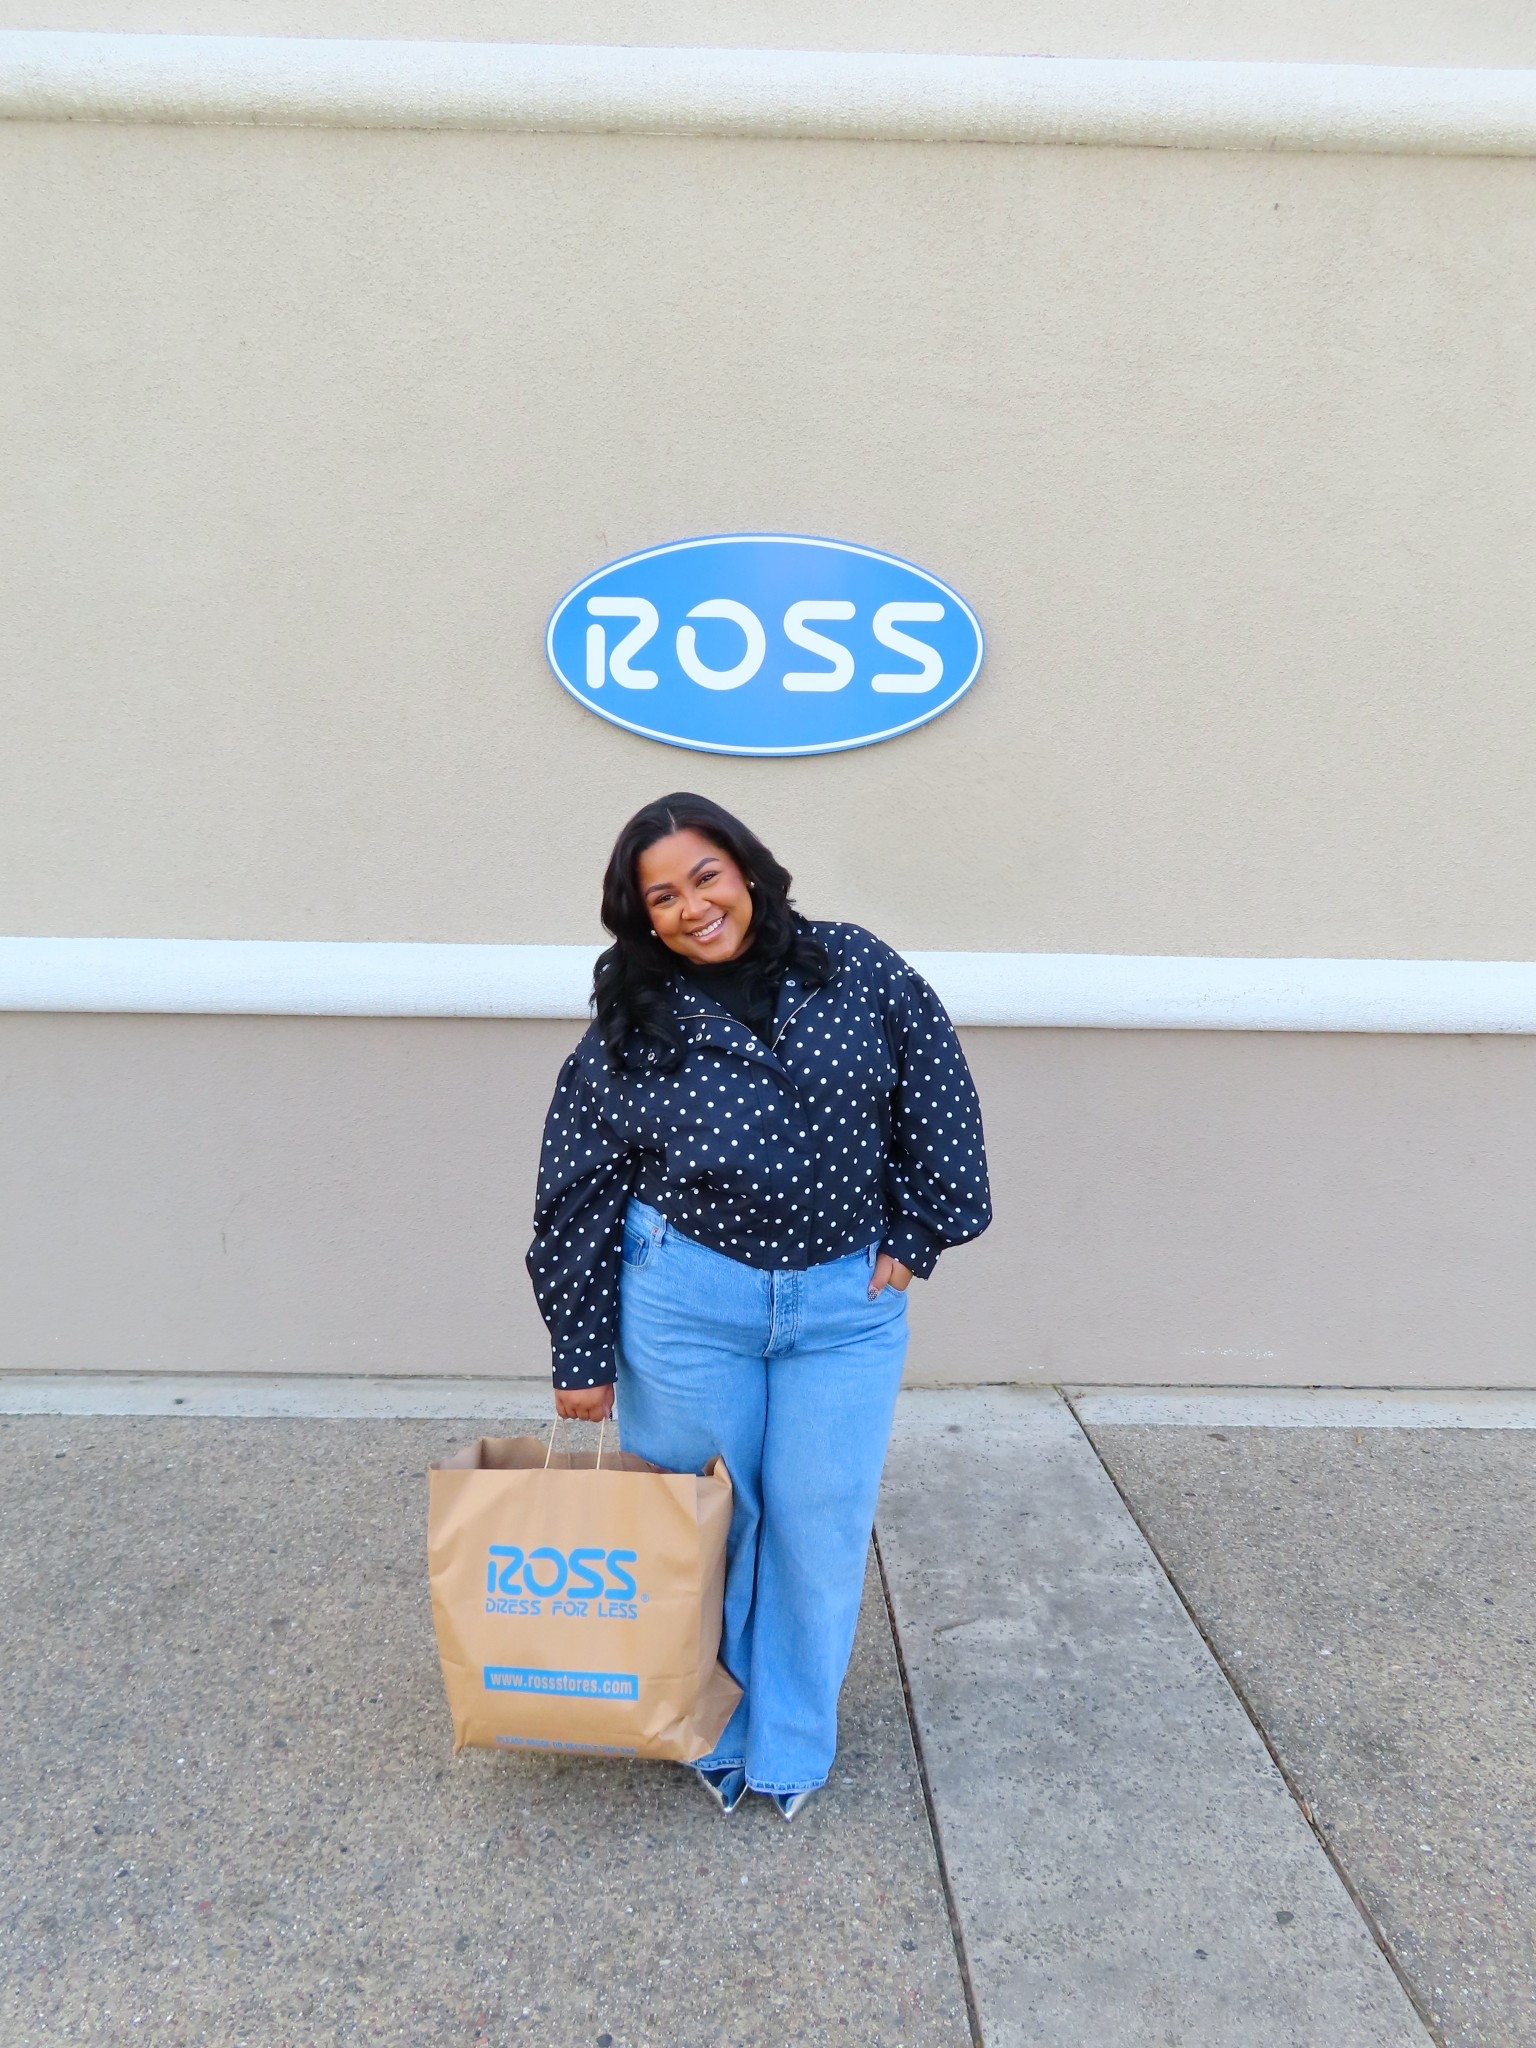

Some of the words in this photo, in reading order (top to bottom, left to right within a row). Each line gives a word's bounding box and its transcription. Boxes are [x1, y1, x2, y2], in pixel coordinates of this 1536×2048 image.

[586, 596, 945, 693] ROSS
[486, 1544, 638, 1600] ROSS
[485, 1597, 541, 1615] DRESS
[552, 1600, 588, 1617] FOR
[598, 1601, 638, 1619] LESS
[490, 1673, 633, 1695] www.rossstores.com
